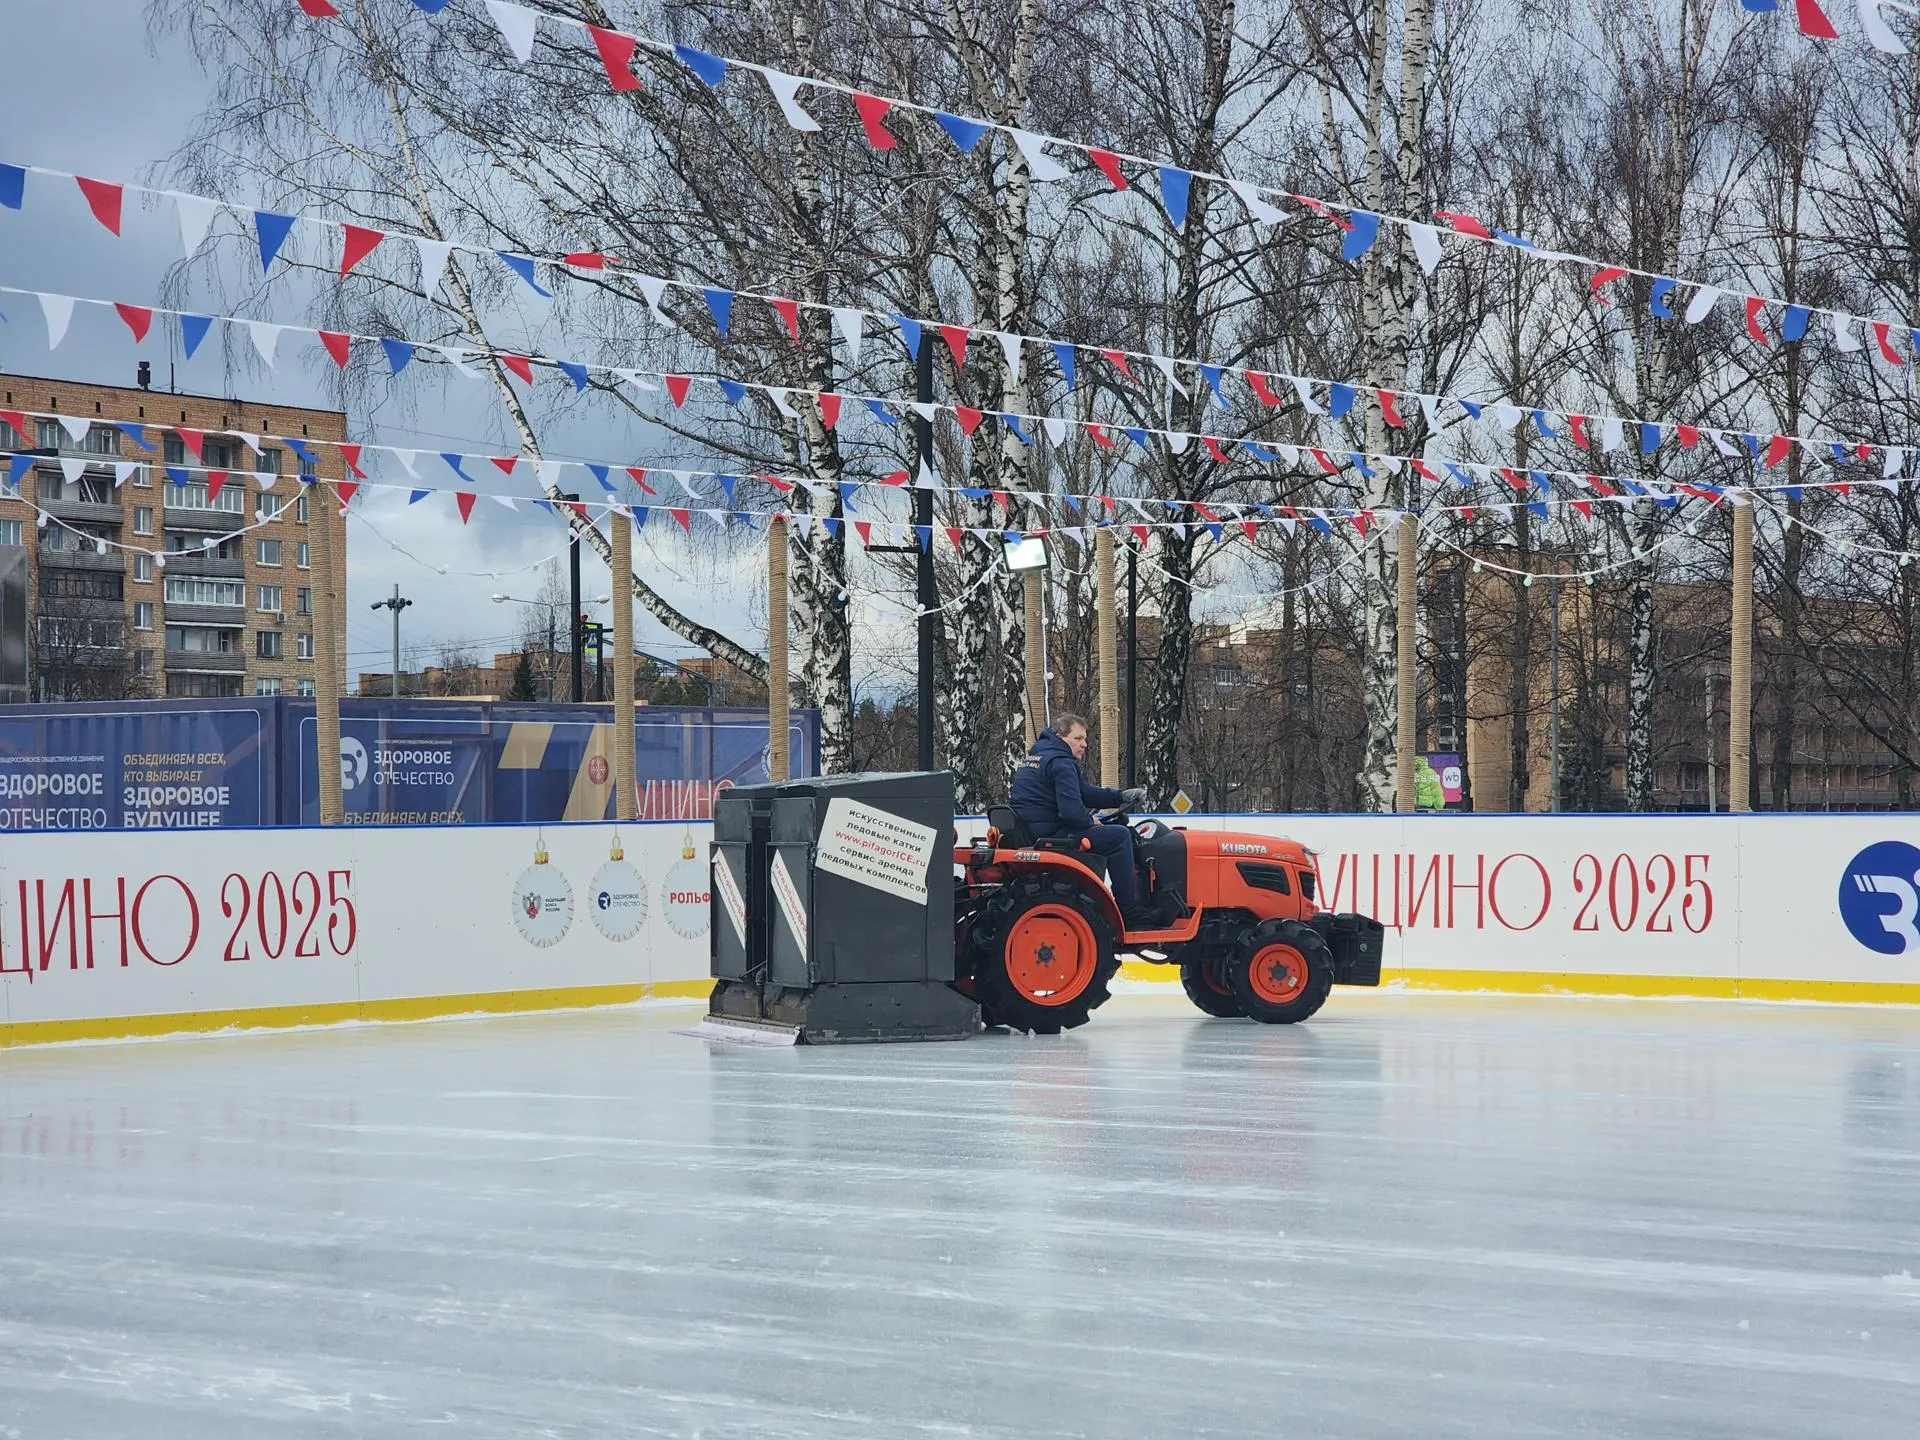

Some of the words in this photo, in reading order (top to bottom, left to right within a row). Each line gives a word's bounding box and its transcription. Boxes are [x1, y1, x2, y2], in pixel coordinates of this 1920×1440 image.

[123, 753, 194, 766] ОБЪЕДИНЯЕМ
[197, 753, 226, 766] ВСЕХ,
[374, 750, 452, 768] ЗДОРОВОЕ
[123, 771, 144, 782] КТО
[146, 770, 202, 782] ВЫБИРАЕТ
[373, 772, 455, 785] ОТЕЧЕСТВО
[1445, 771, 1460, 782] wb
[0, 773, 103, 799] ЗДОРОВОЕ
[123, 786, 229, 808] ЗДОРОВОЕ
[0, 808, 107, 829] ОТЕЧЕСТВО
[123, 811, 220, 828] БУДУЩЕЕ
[343, 812, 427, 824] БЪЕДИНЯЕМ
[849, 809, 926, 842] искусственные
[846, 821, 891, 842] ледовые
[893, 838, 922, 853] катки
[834, 830, 926, 868] www.pifagorICE.ru
[1015, 851, 1041, 861] 4WD
[1221, 843, 1268, 856] KUBOTA
[840, 845, 876, 863] сервис
[878, 859, 914, 876] аренда
[821, 852, 864, 872] ледовых
[866, 868, 927, 894] комплексов
[670, 892, 711, 904] РОЛЬФ
[1312, 853, 1551, 938] УЩИНО
[1572, 853, 1713, 933] 2025
[221, 870, 357, 962] 2025
